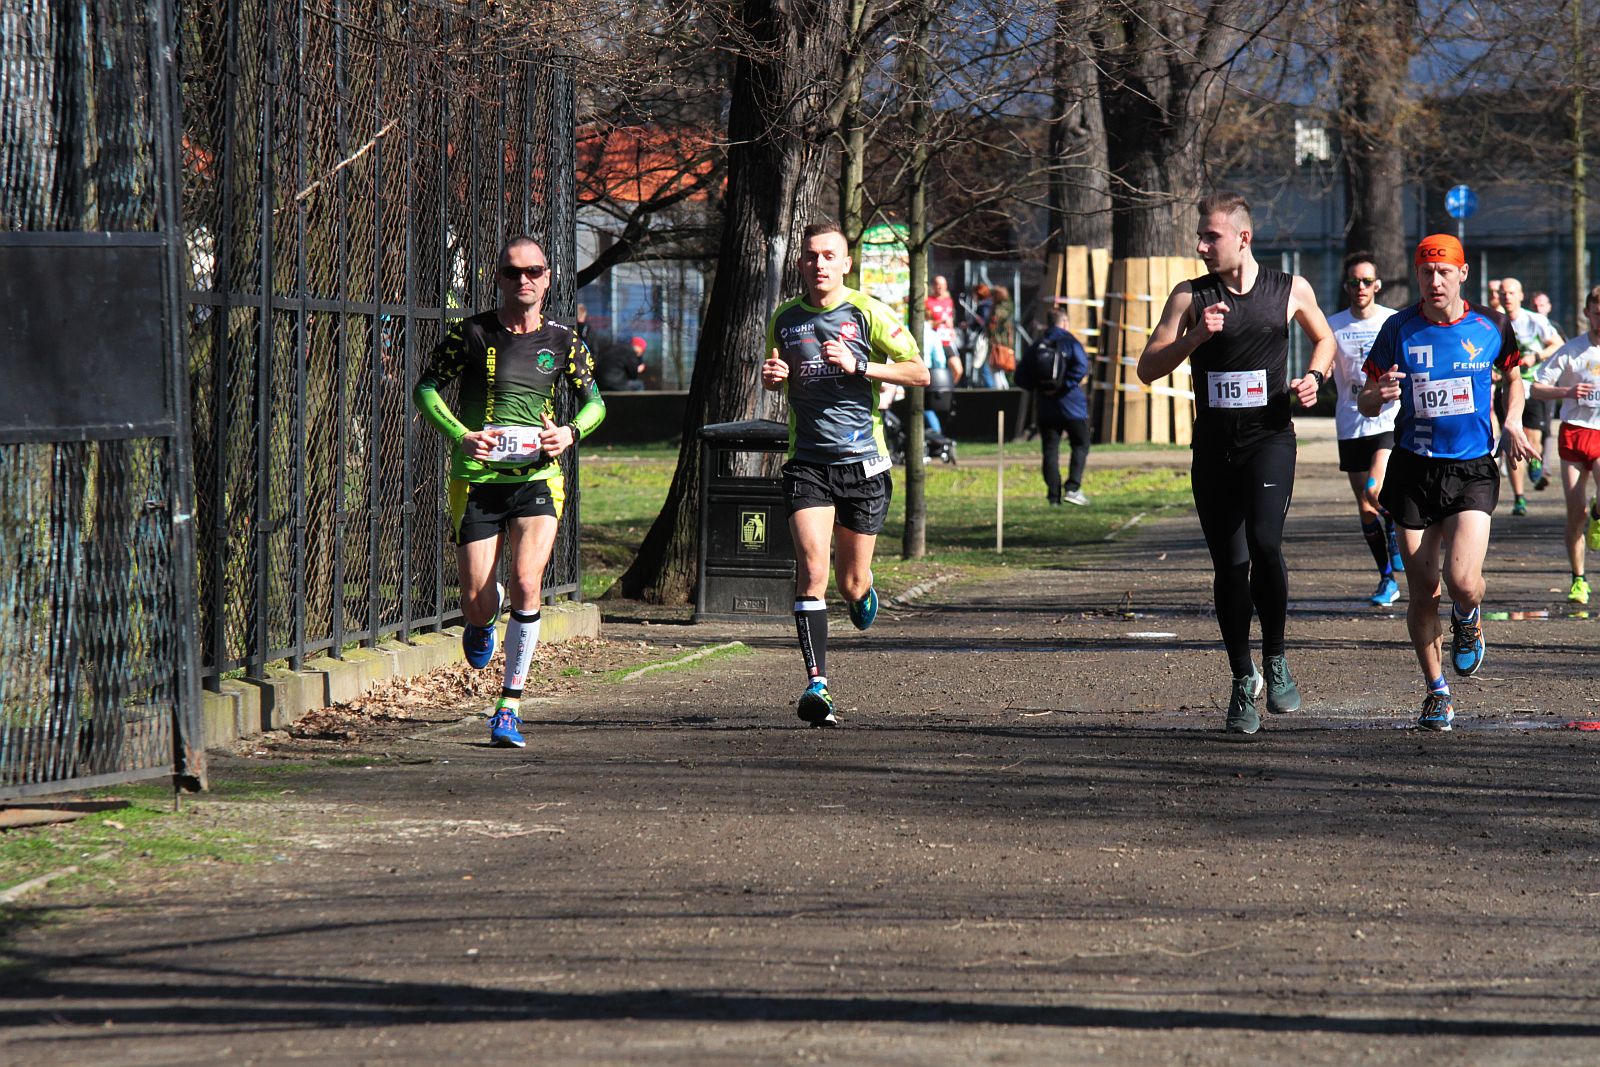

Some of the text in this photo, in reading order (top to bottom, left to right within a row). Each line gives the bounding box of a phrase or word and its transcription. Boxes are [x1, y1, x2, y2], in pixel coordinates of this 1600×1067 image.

[1421, 248, 1446, 258] CCC
[790, 323, 815, 334] KGHM
[1453, 361, 1490, 369] FENIKS
[1215, 382, 1241, 399] 115
[1419, 389, 1448, 409] 192
